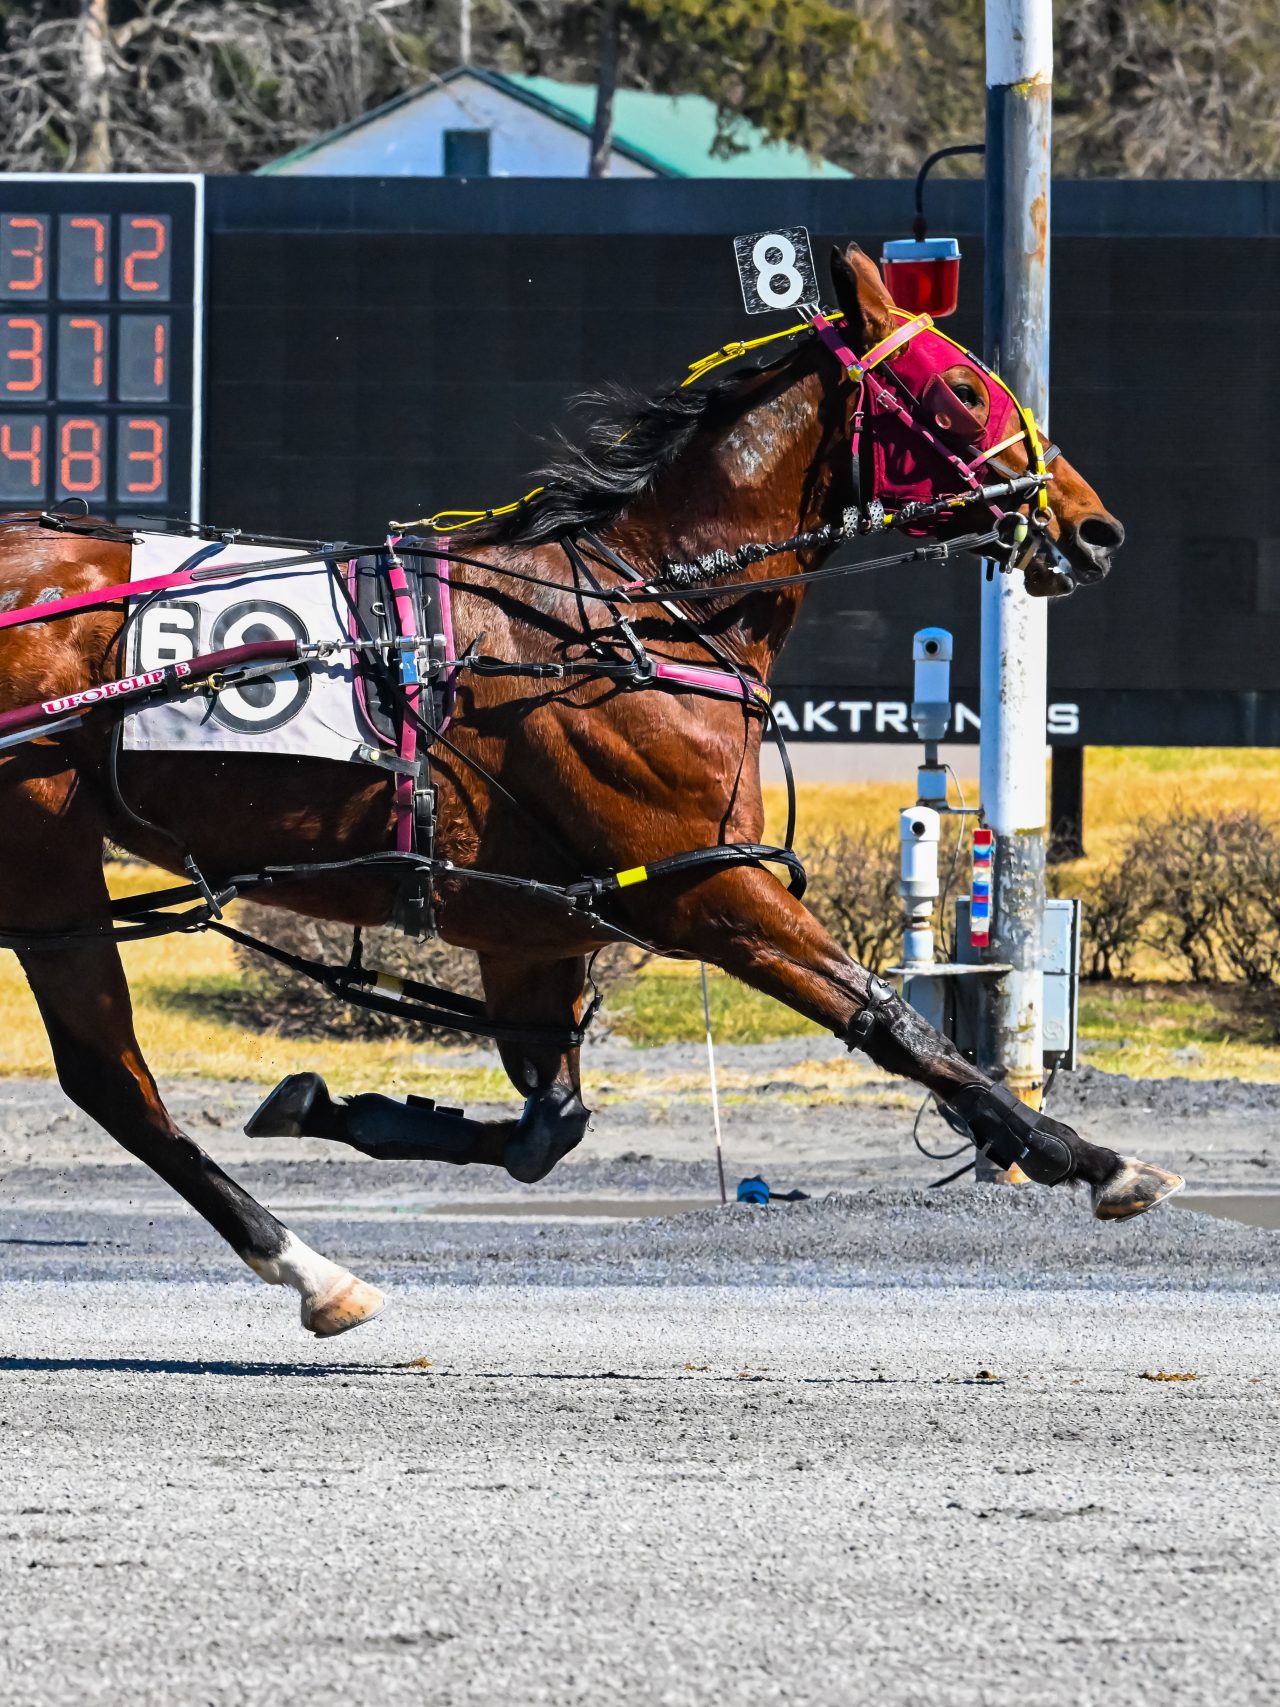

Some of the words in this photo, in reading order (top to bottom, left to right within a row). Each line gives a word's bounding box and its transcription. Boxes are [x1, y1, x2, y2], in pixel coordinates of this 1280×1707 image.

[8, 218, 165, 291] 372
[752, 233, 804, 309] 8
[7, 318, 164, 391] 371
[1, 419, 163, 492] 483
[141, 607, 195, 673] 6
[42, 661, 192, 714] UFOECLIPE
